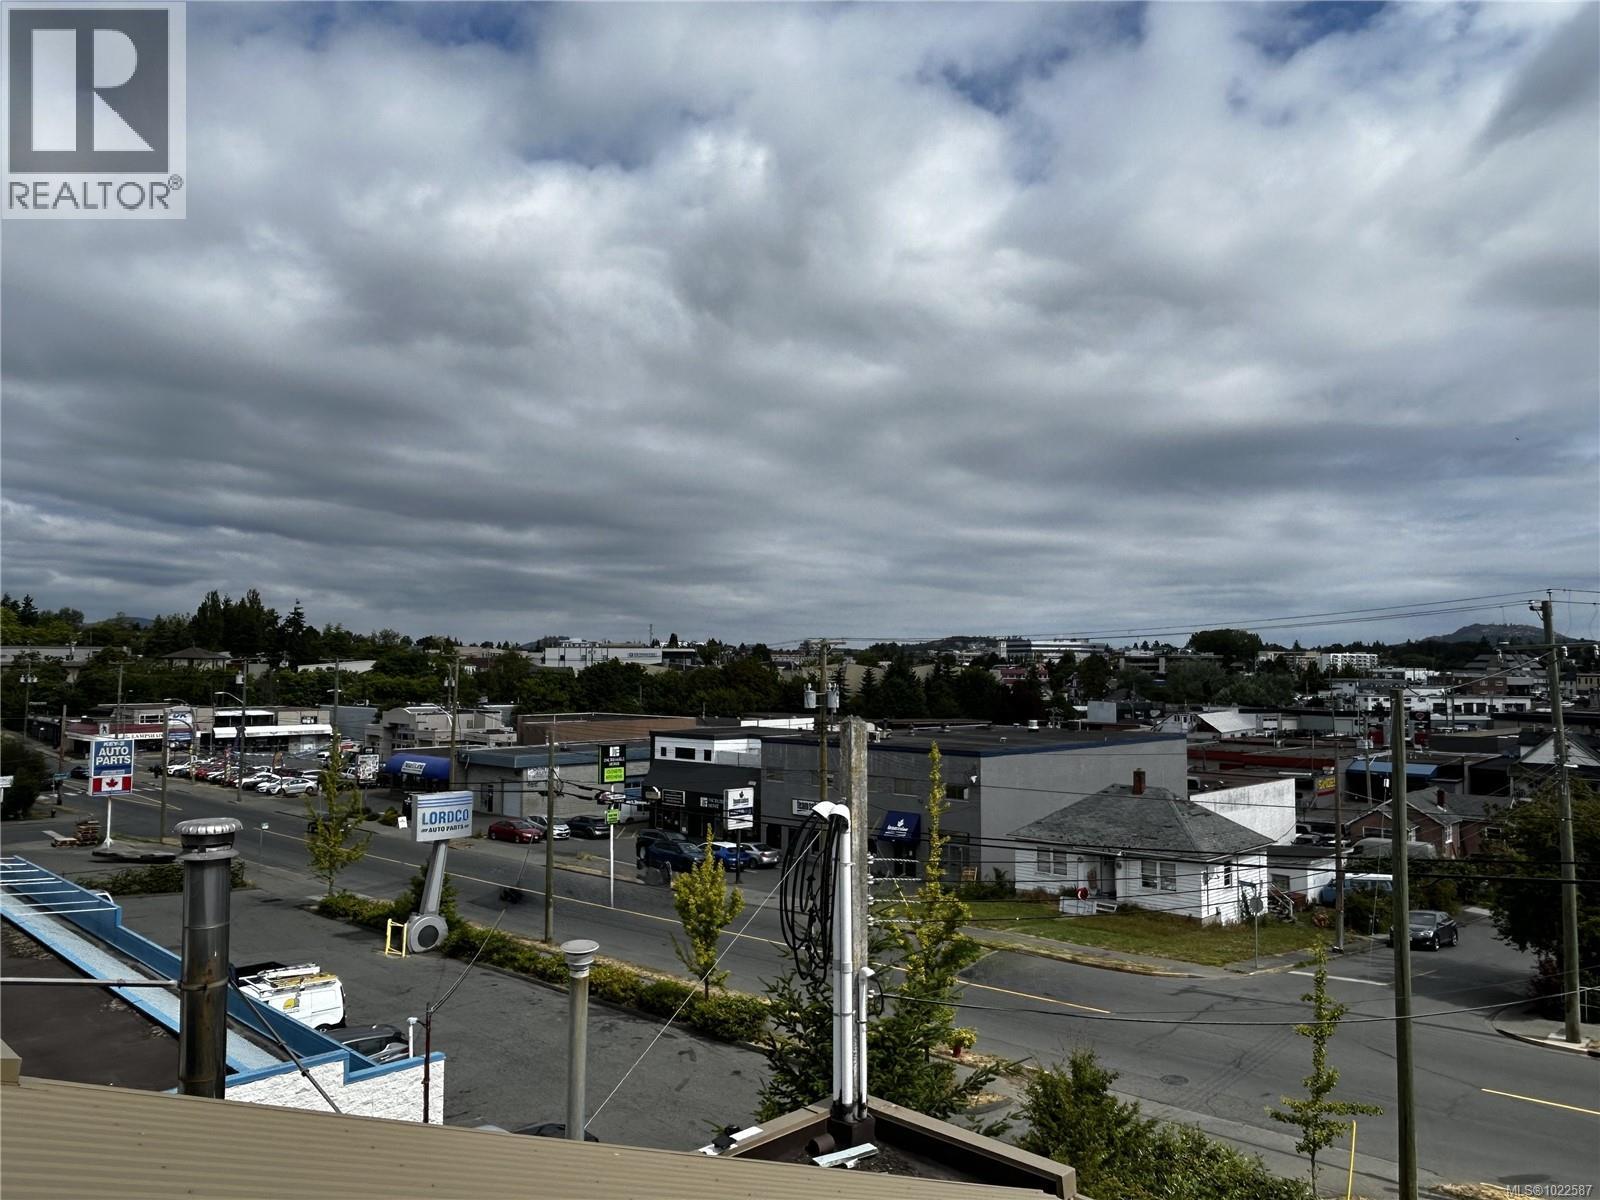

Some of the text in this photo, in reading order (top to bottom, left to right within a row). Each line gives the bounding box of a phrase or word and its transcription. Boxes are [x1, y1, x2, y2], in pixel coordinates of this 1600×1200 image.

[98, 746, 129, 756] AUTO
[96, 755, 131, 765] PARTS
[421, 809, 469, 825] LORDCO
